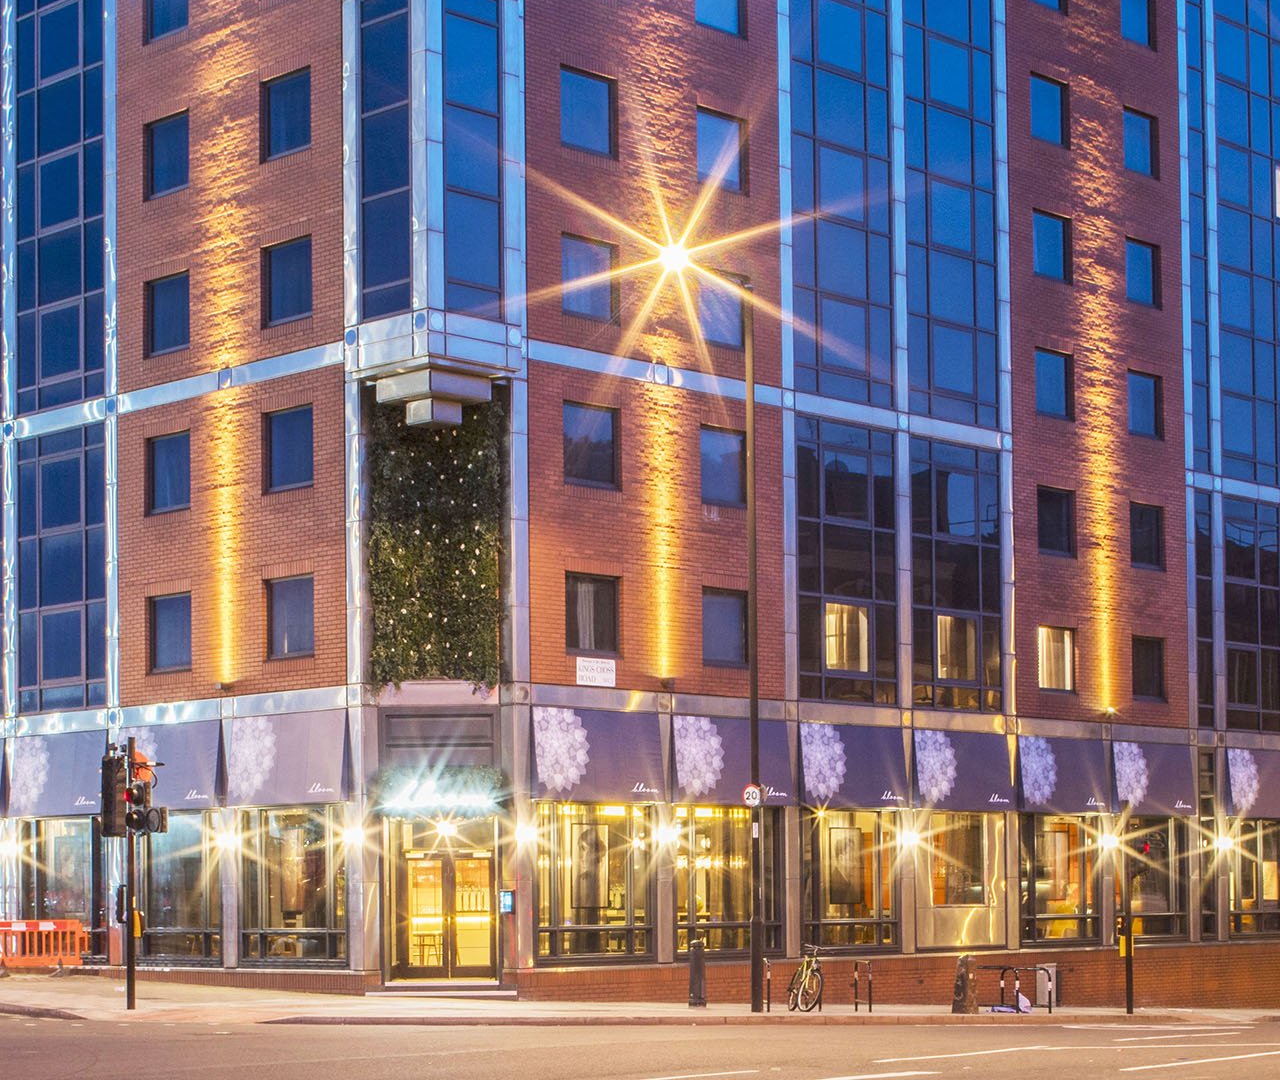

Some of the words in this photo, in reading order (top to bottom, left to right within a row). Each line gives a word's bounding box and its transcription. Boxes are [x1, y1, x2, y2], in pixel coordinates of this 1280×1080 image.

[307, 782, 335, 793] bloom
[631, 782, 660, 794] bloom
[745, 791, 757, 800] 20
[881, 790, 904, 801] bloom
